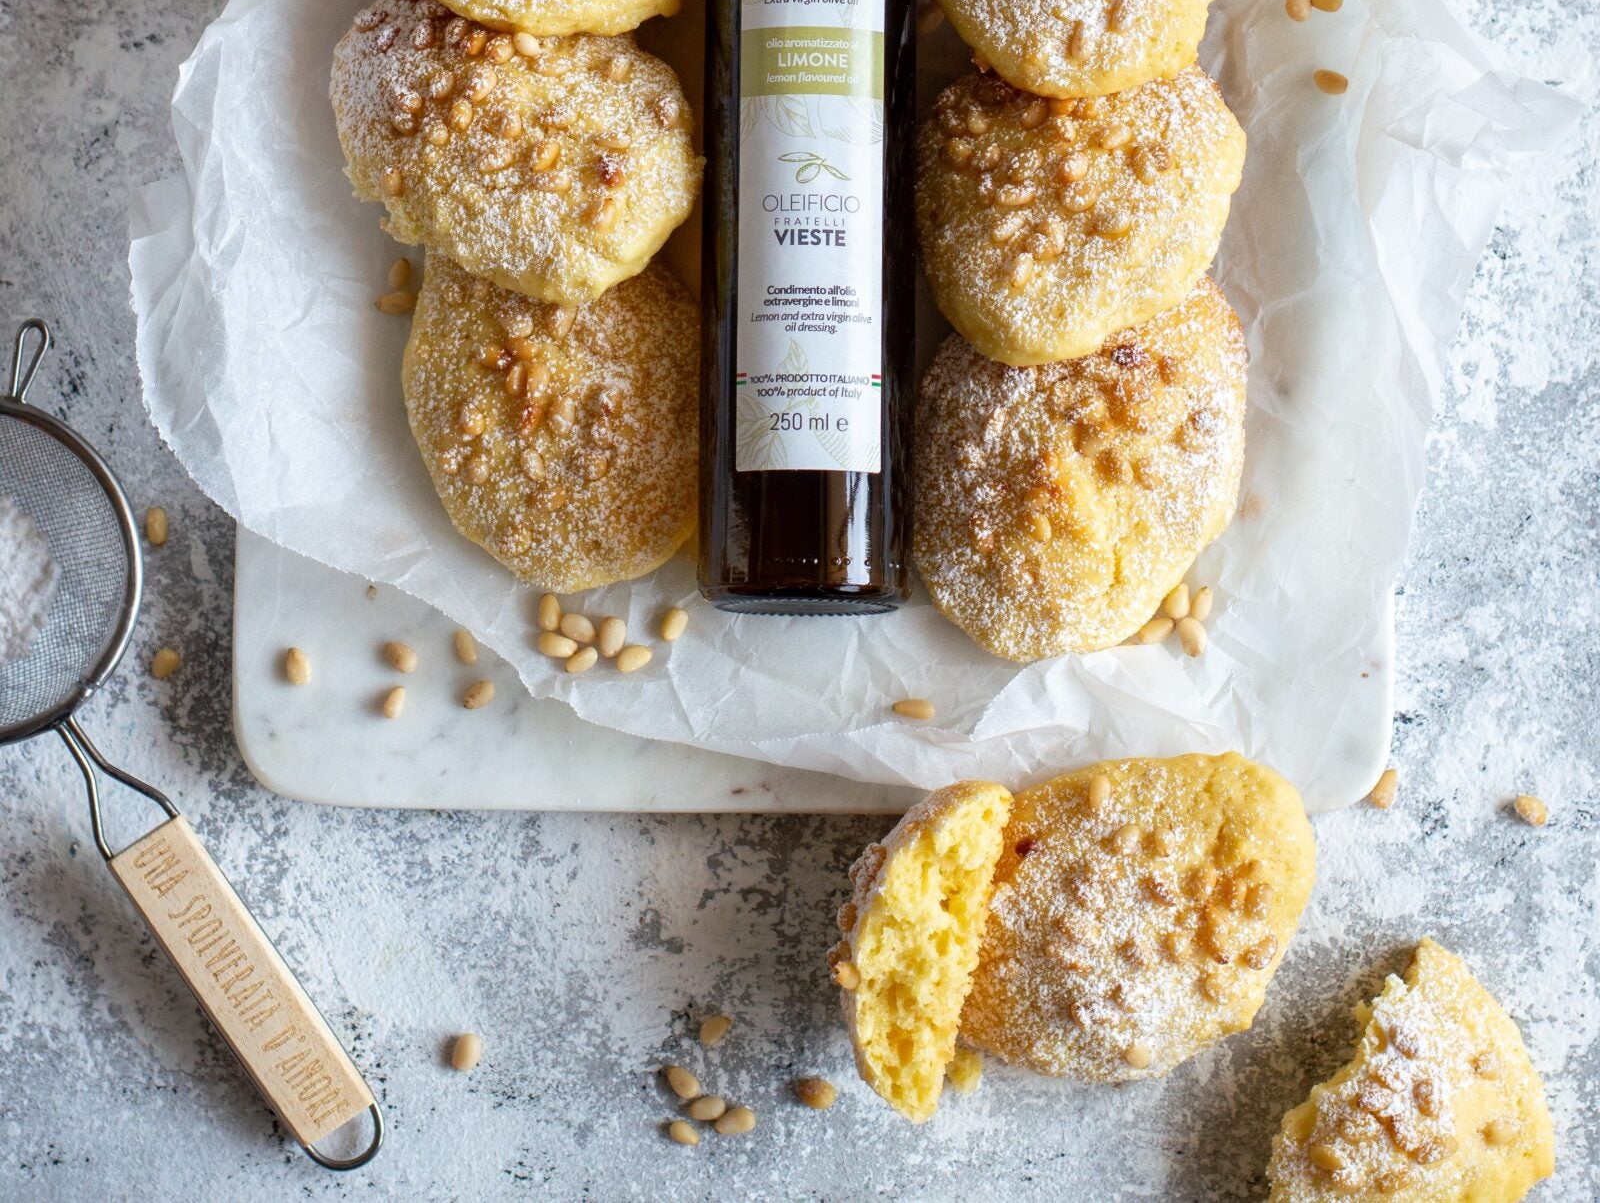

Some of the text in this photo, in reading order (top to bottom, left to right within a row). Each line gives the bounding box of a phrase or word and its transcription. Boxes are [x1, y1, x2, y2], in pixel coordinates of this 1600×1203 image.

[766, 38, 783, 49] olio
[784, 38, 849, 49] aromatizzato
[777, 52, 849, 68] LIMONE
[766, 73, 796, 84] lemon
[797, 71, 846, 84] flavoured
[762, 193, 860, 213] OLEIFICIO
[774, 217, 845, 227] FRATELLI
[774, 228, 846, 247] VIESTE
[767, 285, 857, 296] Condimento all'olio
[763, 296, 860, 308] extravergine e limoni
[751, 313, 779, 323] Lemon
[781, 311, 799, 322] and
[800, 312, 824, 322] extra
[826, 311, 851, 324] virgin
[785, 322, 838, 334] oil dressing.
[750, 373, 870, 385] 100% PRODOTTO ITALIANO
[757, 386, 863, 400] 100% product of Italy
[770, 412, 803, 431] 250
[809, 413, 829, 431] ml
[131, 837, 190, 899] UNA
